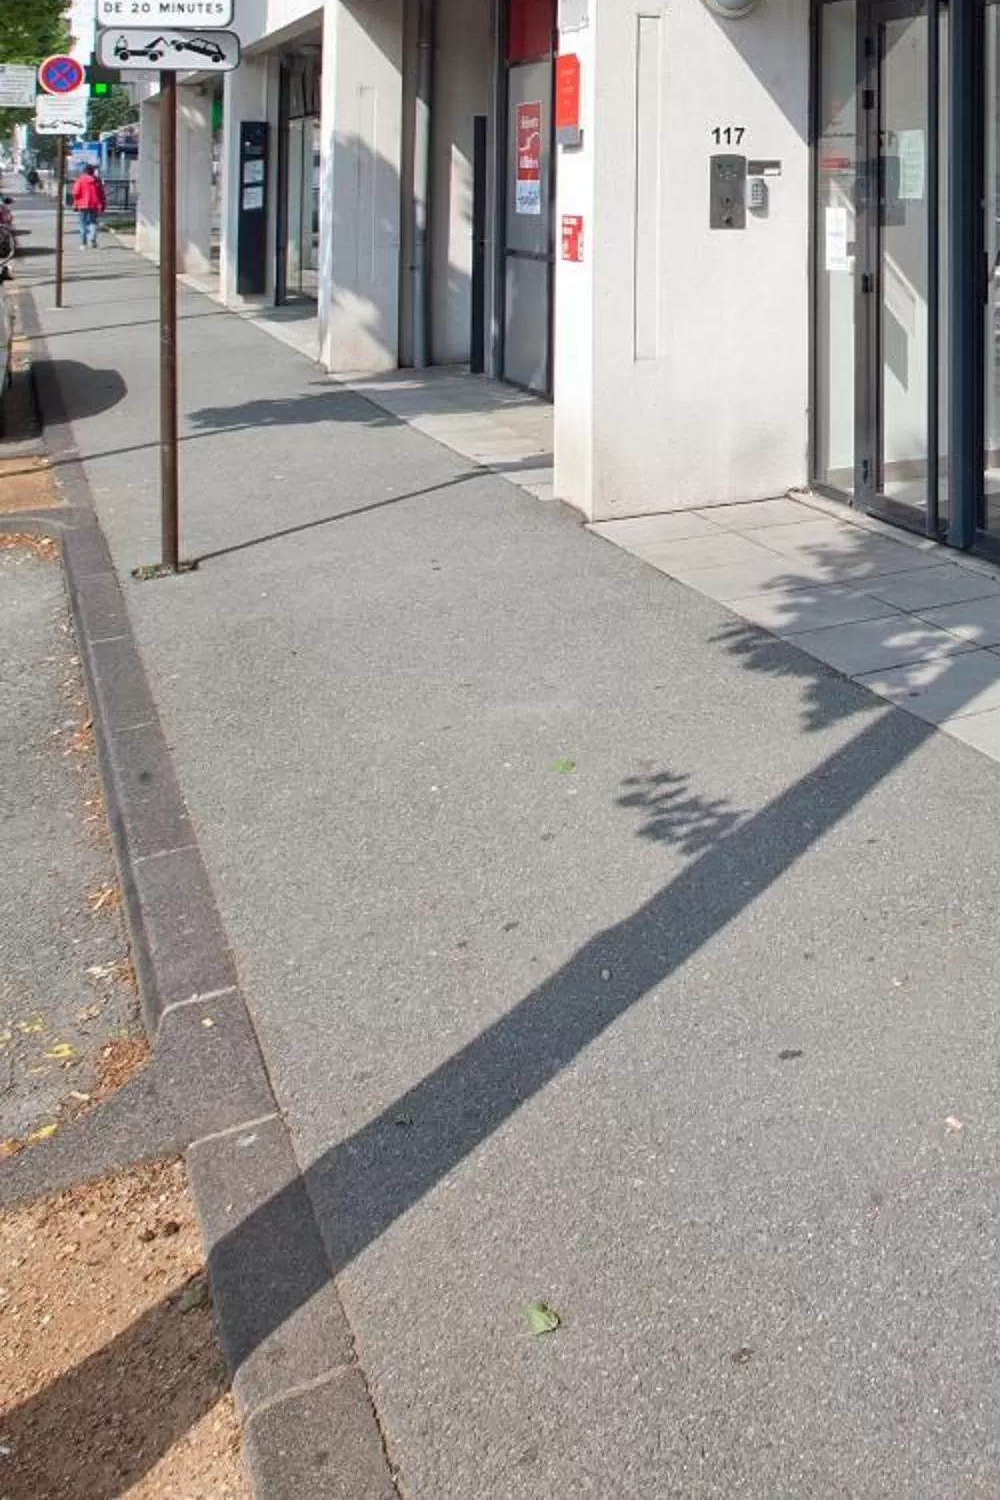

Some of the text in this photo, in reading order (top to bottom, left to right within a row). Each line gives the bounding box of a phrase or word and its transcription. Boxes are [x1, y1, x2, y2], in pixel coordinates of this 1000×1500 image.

[103, 3, 225, 14] DE 20 MINUTES
[711, 127, 746, 145] 117
